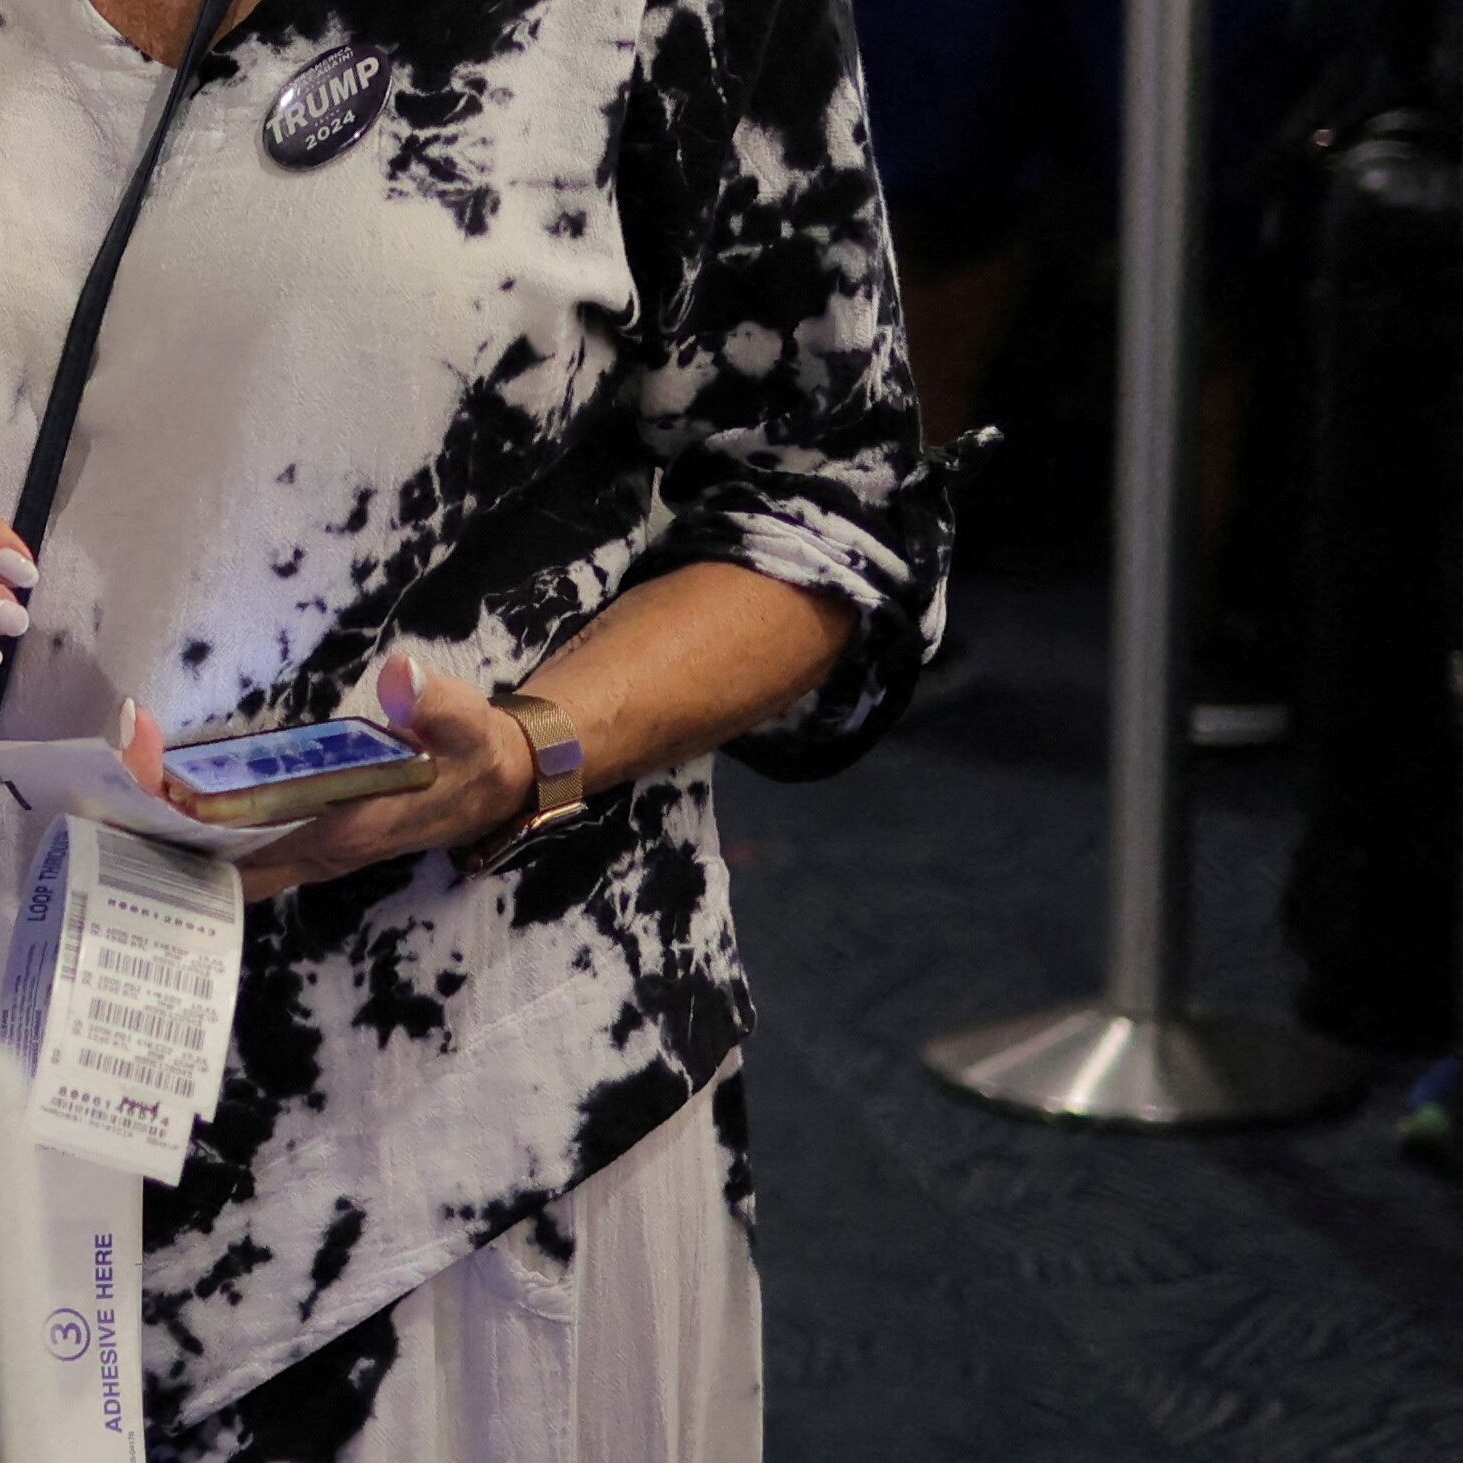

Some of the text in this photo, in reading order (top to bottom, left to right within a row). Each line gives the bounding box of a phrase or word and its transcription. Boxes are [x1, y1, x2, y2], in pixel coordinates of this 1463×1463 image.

[266, 57, 380, 144] TRUMP
[305, 109, 356, 151] 2024
[26, 886, 53, 922] LOOP
[50, 1322, 82, 1345] 3
[95, 1233, 123, 1433] ADHESIVE HERE
